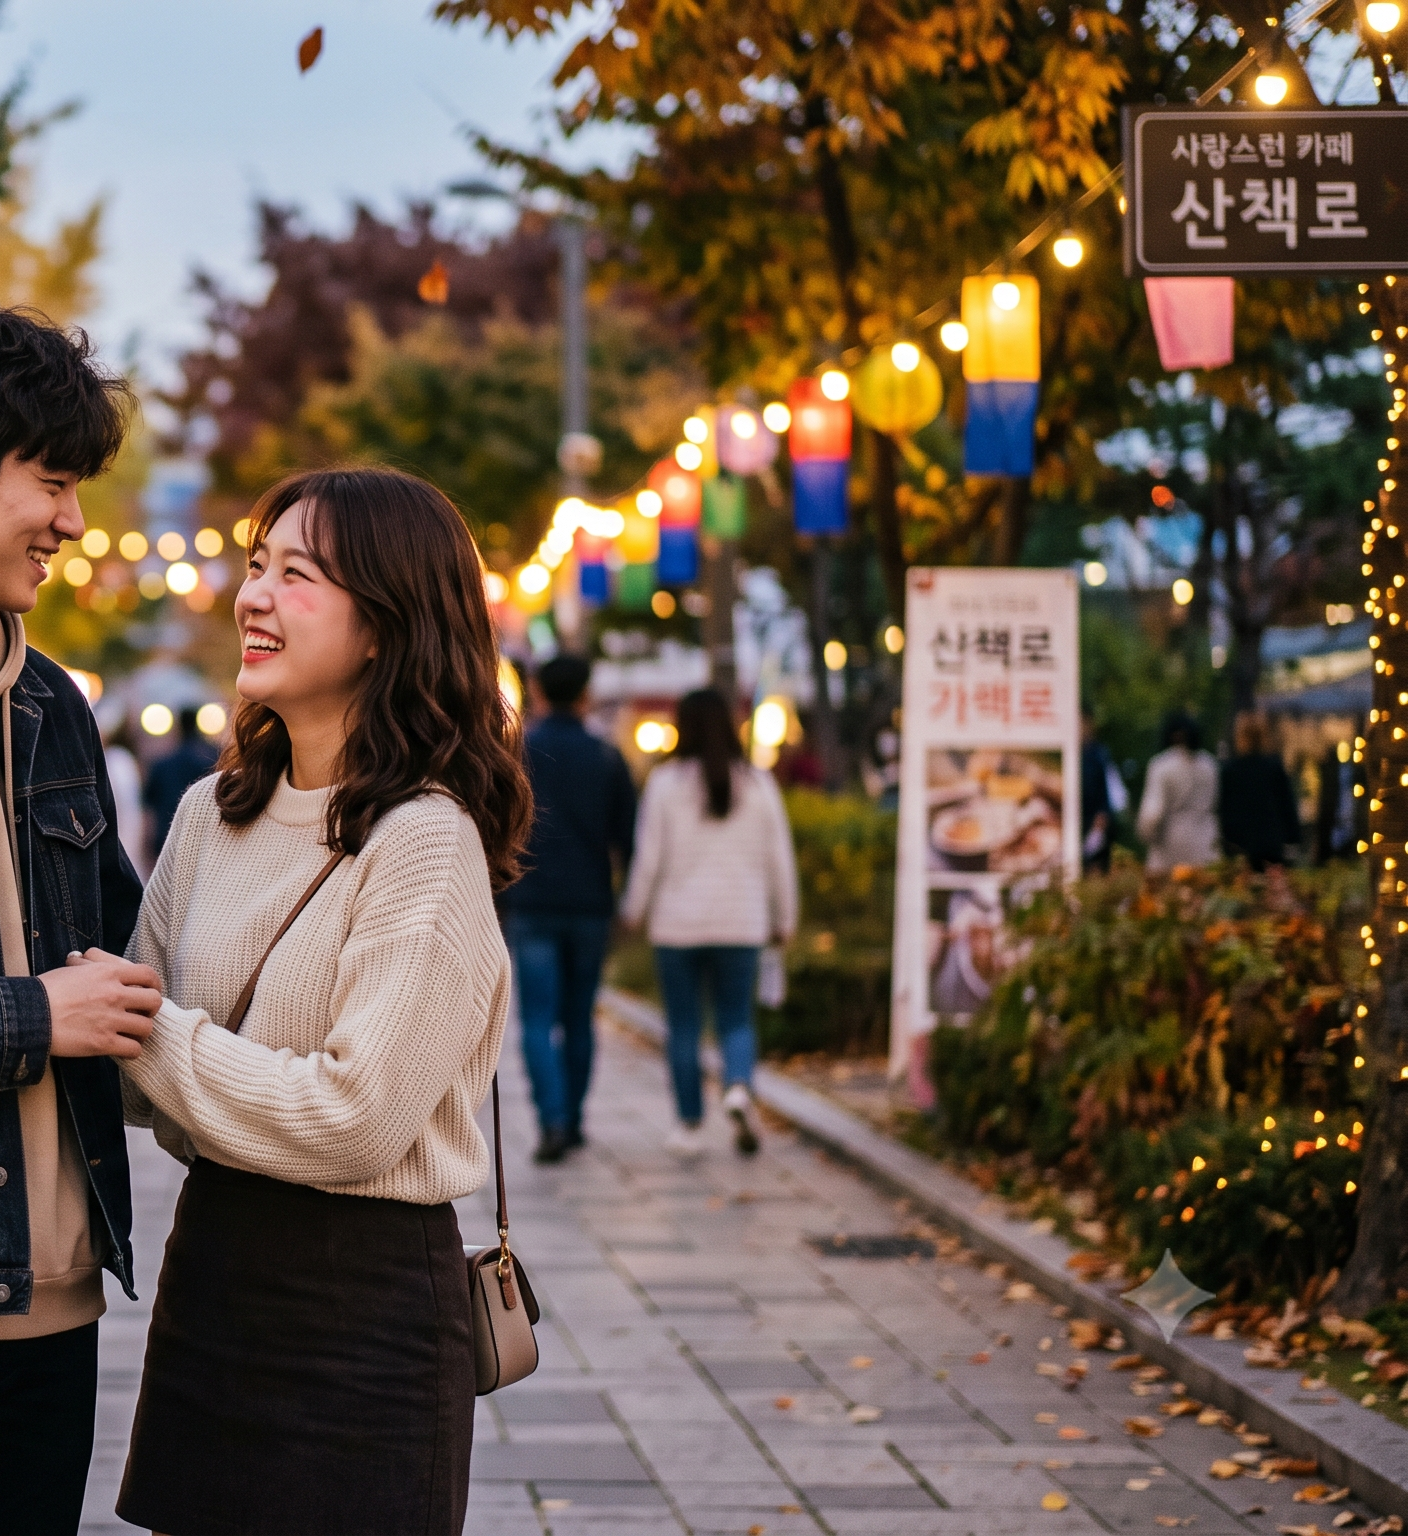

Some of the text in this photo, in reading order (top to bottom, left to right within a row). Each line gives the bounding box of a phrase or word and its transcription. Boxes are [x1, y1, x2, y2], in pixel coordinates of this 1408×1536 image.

[1171, 131, 1354, 170] 사랑스런 카페
[1170, 177, 1368, 250] 산책로
